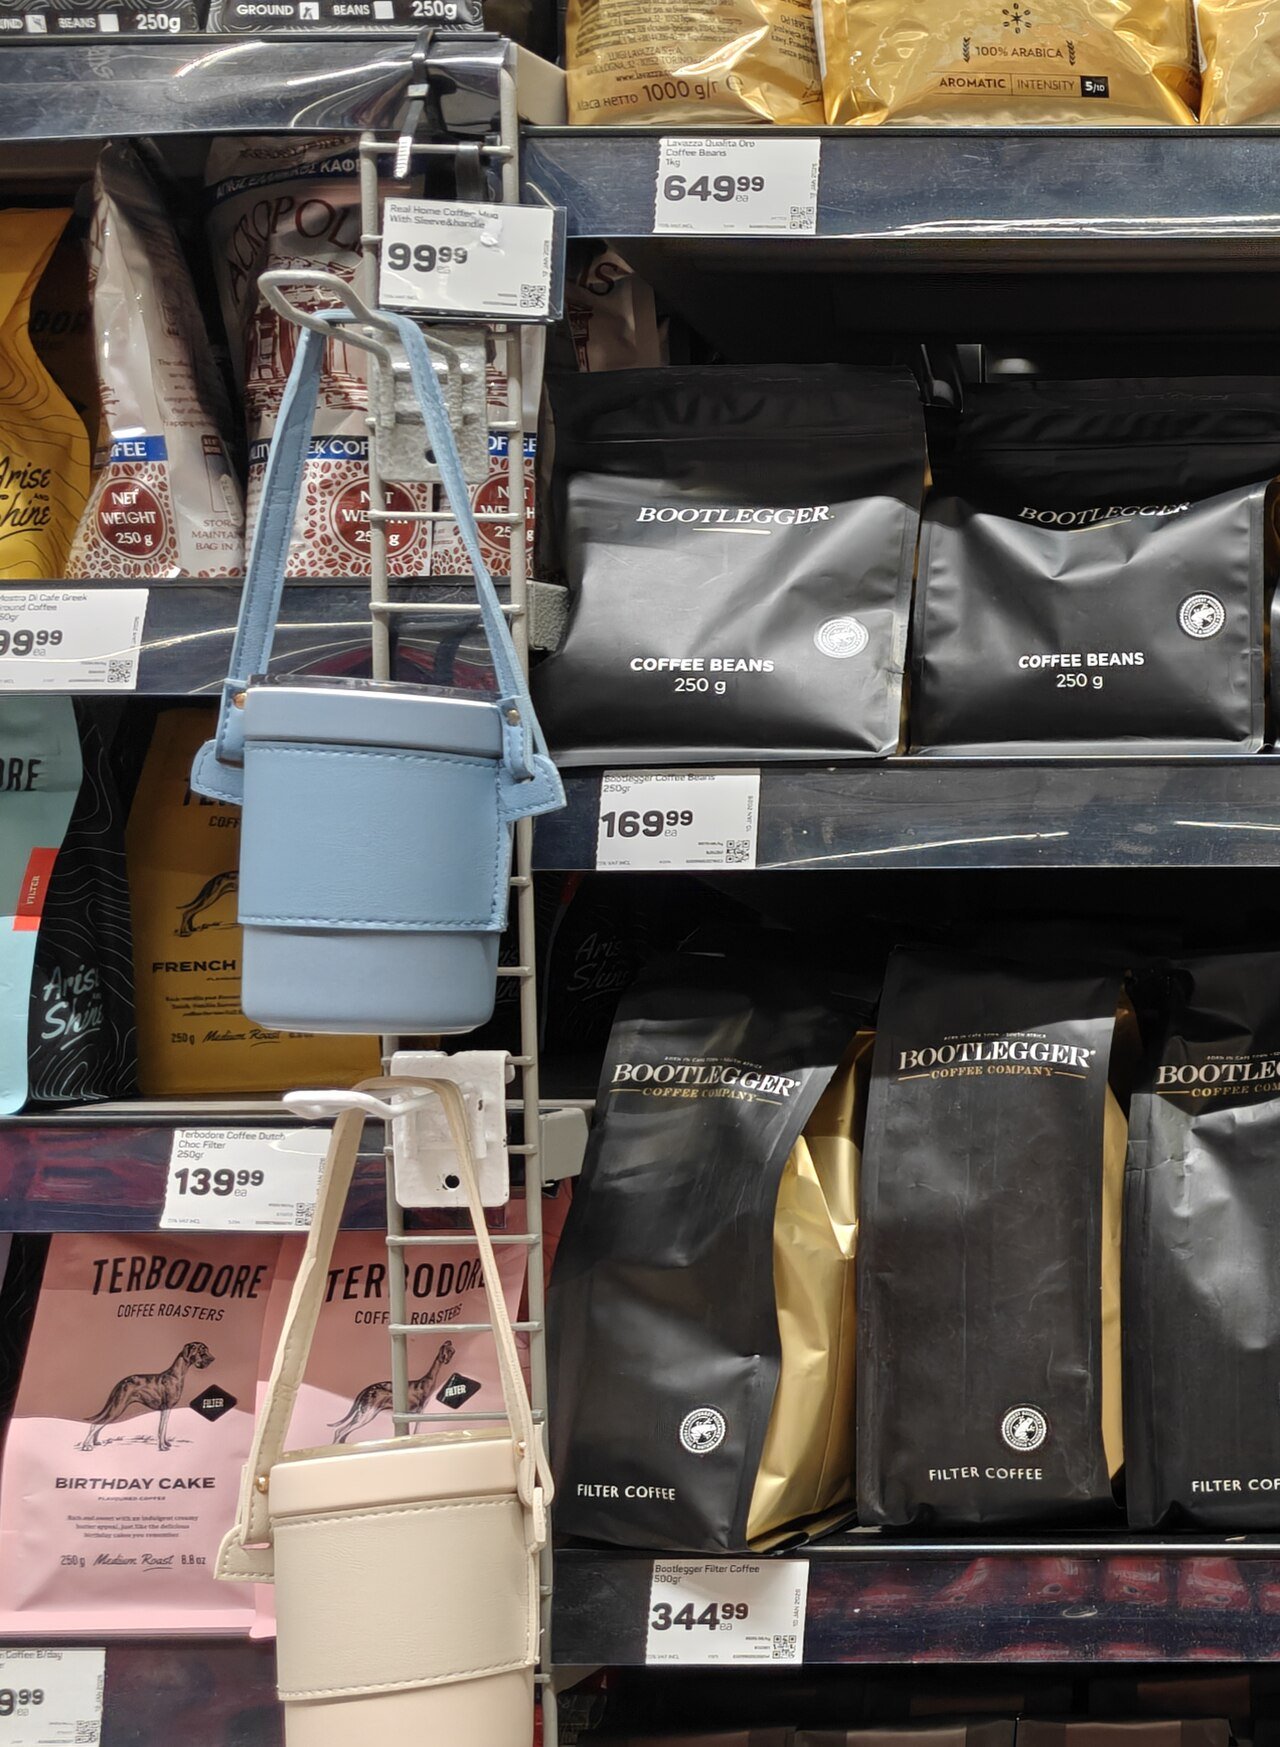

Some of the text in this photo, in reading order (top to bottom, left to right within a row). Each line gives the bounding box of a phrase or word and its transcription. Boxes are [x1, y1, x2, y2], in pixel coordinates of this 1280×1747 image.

[237, 1, 457, 20] GROUND BEANS 250g
[975, 45, 1063, 60] 100% ARABICA
[939, 77, 1006, 89] AROMATIC
[1016, 77, 1075, 92] INTENSITY
[666, 158, 680, 167] 1kg
[111, 491, 138, 505] NET
[101, 511, 156, 527] WEIGHT
[115, 531, 153, 548] 250 g
[630, 657, 774, 673] COFFEE BEANS
[1019, 651, 1145, 669] COFFEE BEANS
[151, 959, 236, 973] FRENCH
[92, 1255, 267, 1299] TERBODORE
[117, 1304, 225, 1322] COFFEE ROASTERS
[929, 1465, 1043, 1482] FILTER COFFEE
[55, 1477, 215, 1490] BIRTHDAY CAKE
